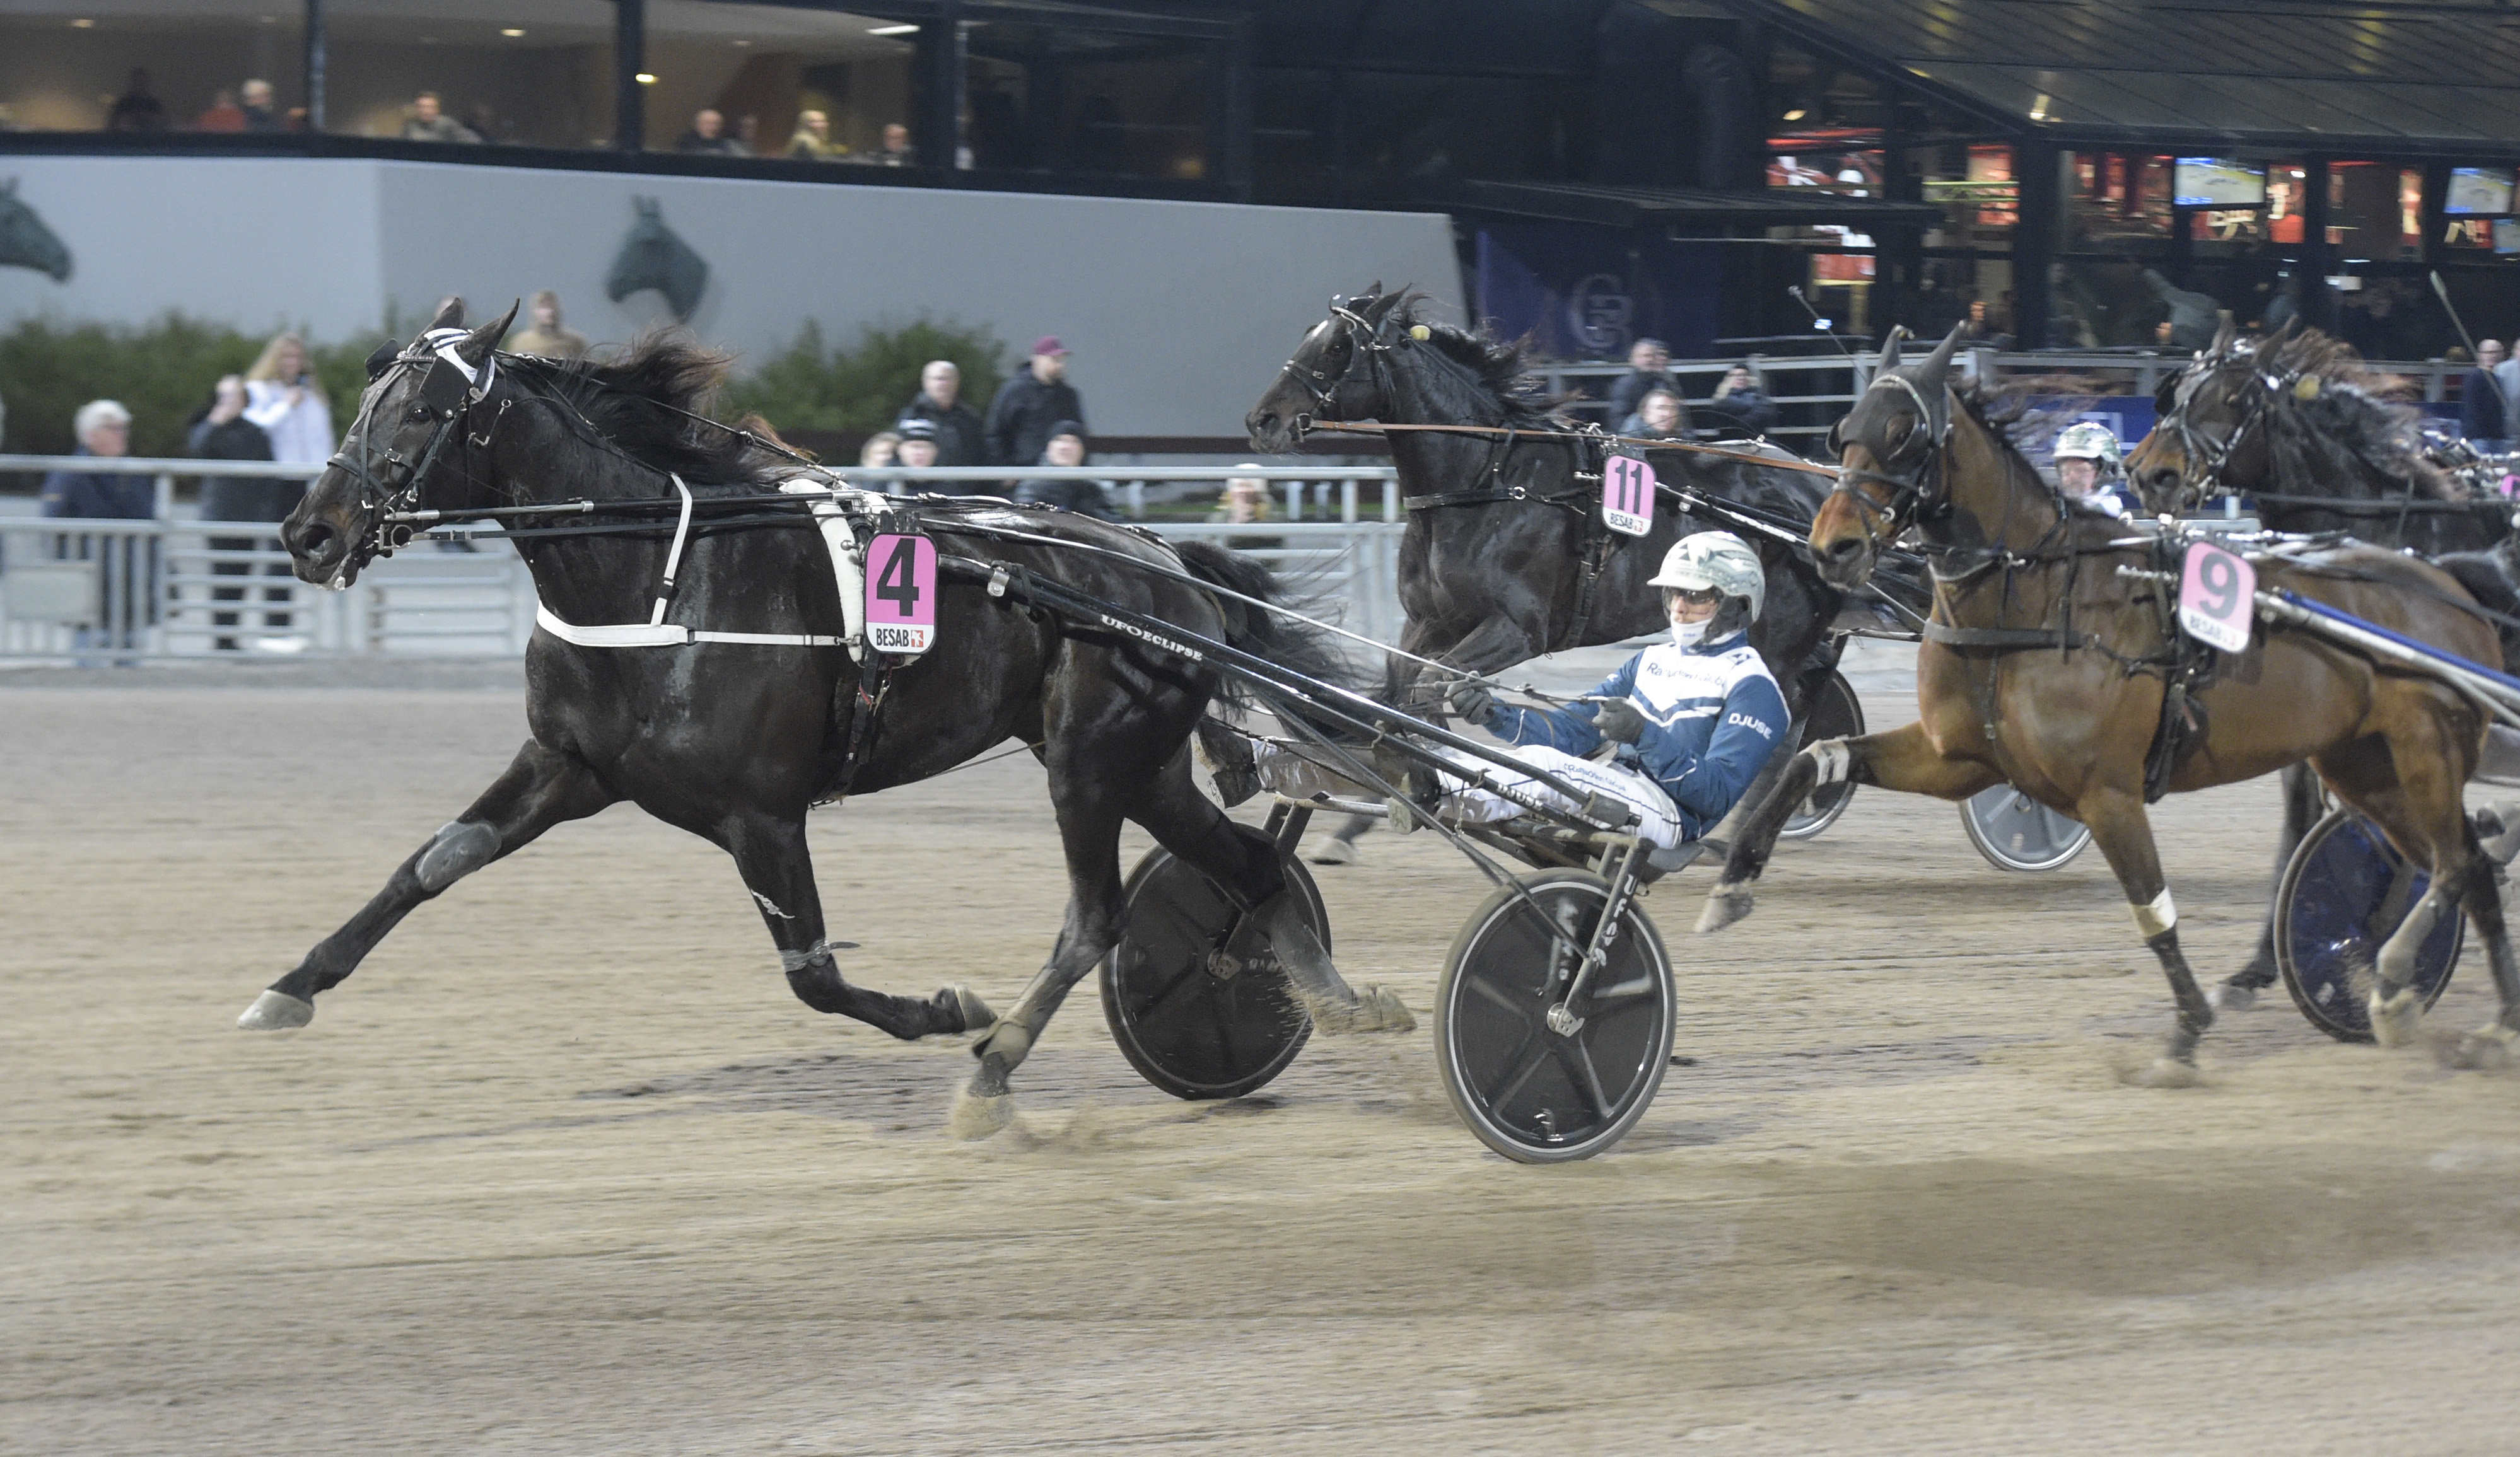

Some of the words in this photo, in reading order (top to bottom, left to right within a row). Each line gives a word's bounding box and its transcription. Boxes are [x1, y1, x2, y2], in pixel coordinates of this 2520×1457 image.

[1615, 459, 1642, 515] 11
[1609, 513, 1634, 529] BESAB
[877, 538, 919, 617] 4
[2198, 552, 2239, 619] 9
[876, 628, 909, 647] BESAB
[1101, 613, 1205, 661] UFOECLIPSE
[1728, 712, 1773, 740] DJUSE
